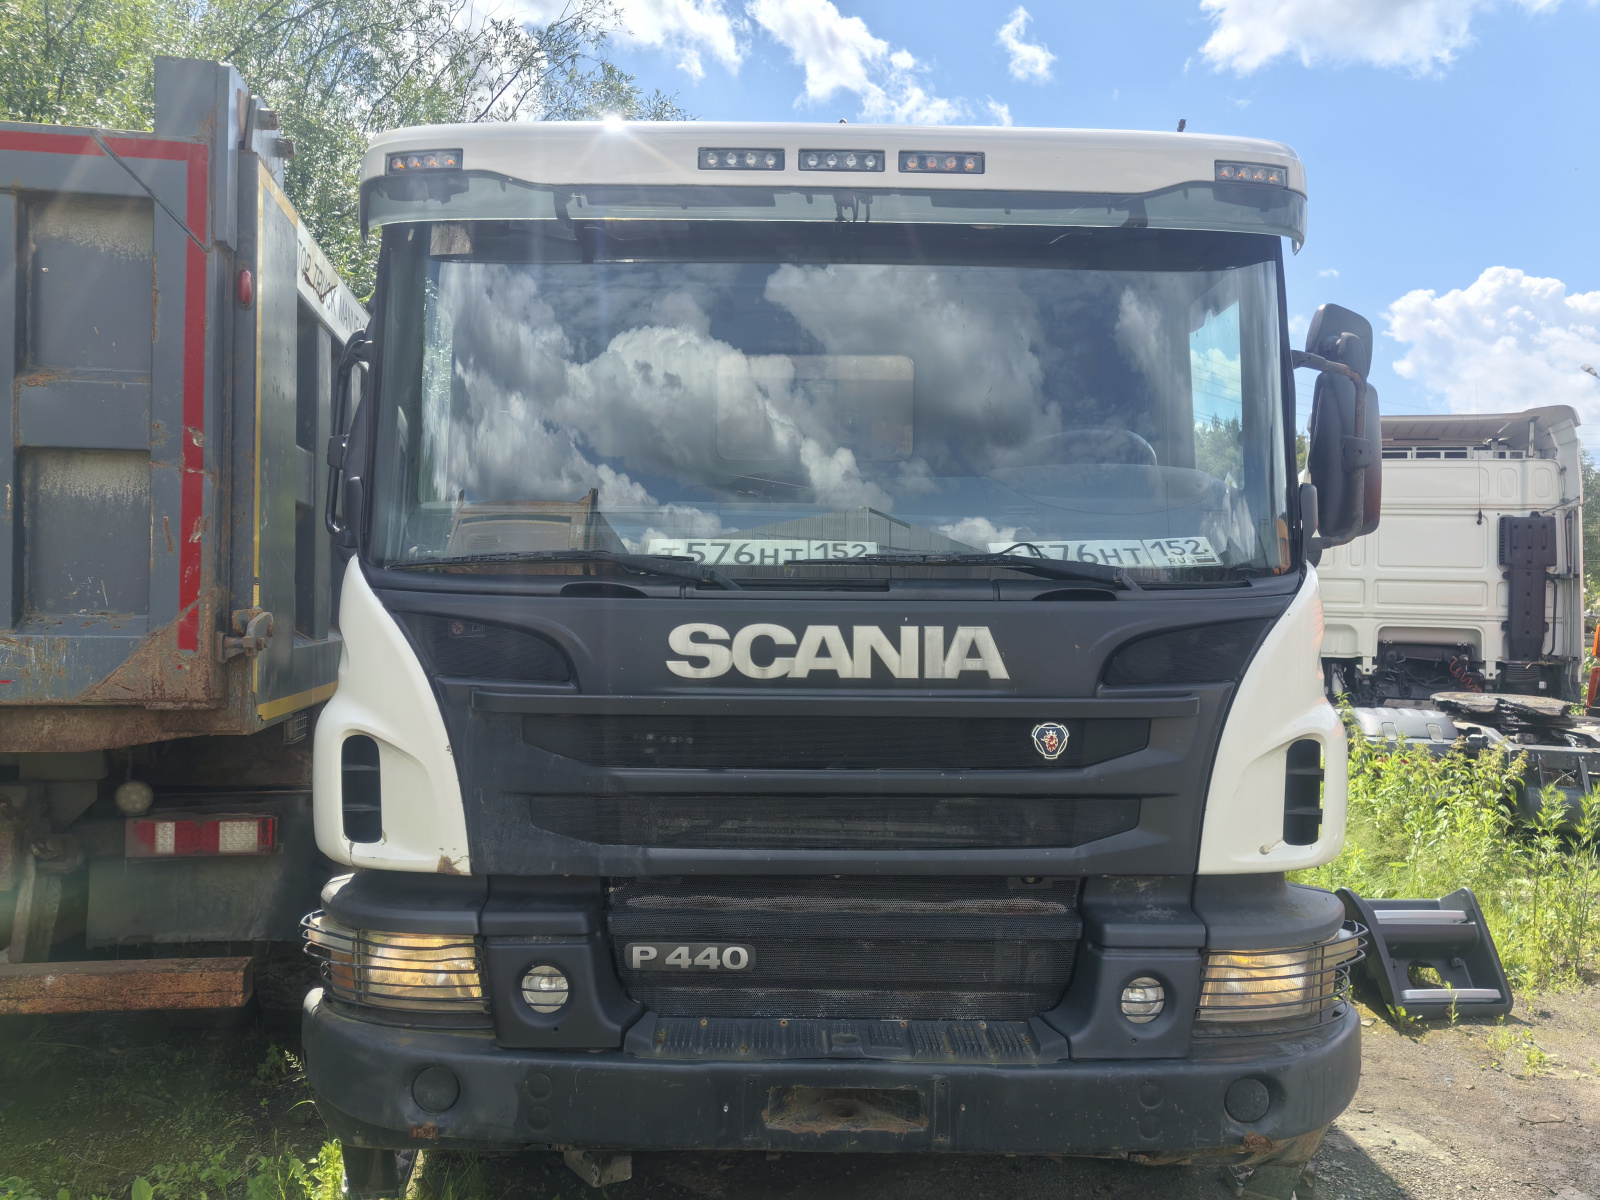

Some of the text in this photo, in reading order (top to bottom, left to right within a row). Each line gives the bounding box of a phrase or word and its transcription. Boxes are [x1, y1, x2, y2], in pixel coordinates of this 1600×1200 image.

[313, 262, 337, 317] TRUCK
[1150, 539, 1207, 556] 152
[1168, 556, 1197, 565] RUS
[665, 622, 1011, 680] SCANIA
[632, 946, 749, 970] P 440
